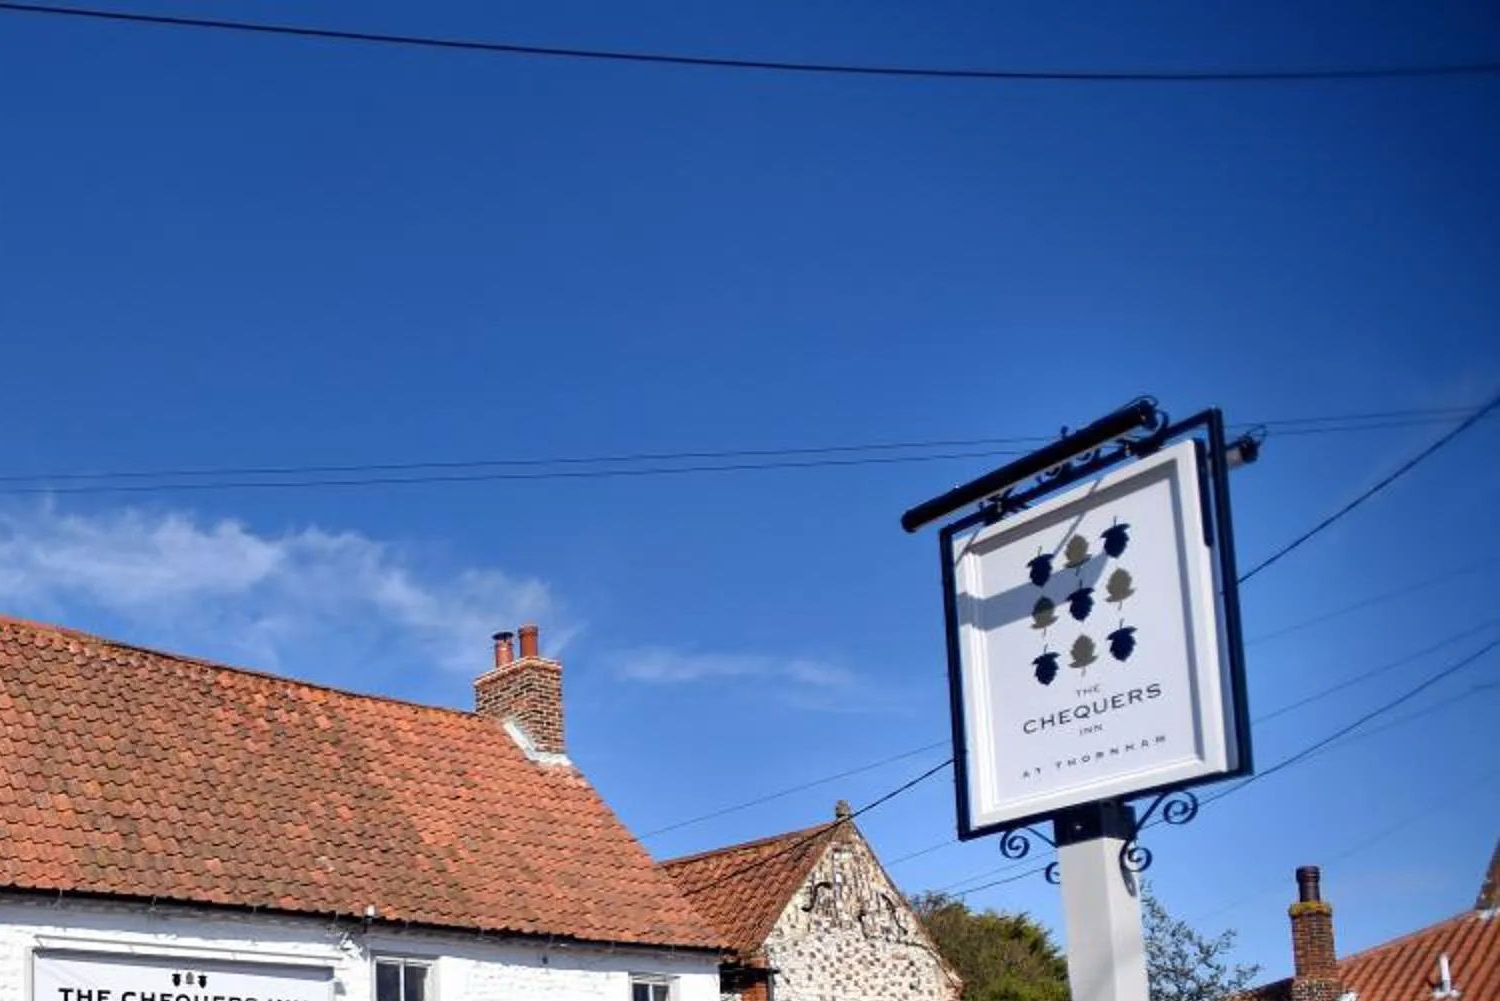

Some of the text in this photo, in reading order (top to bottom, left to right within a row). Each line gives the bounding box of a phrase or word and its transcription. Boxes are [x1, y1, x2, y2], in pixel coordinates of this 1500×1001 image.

[1076, 685, 1100, 697] THE
[1023, 683, 1162, 734] CHEQUERS
[1079, 724, 1103, 736] INN
[1022, 735, 1166, 778] AT THORNHAM
